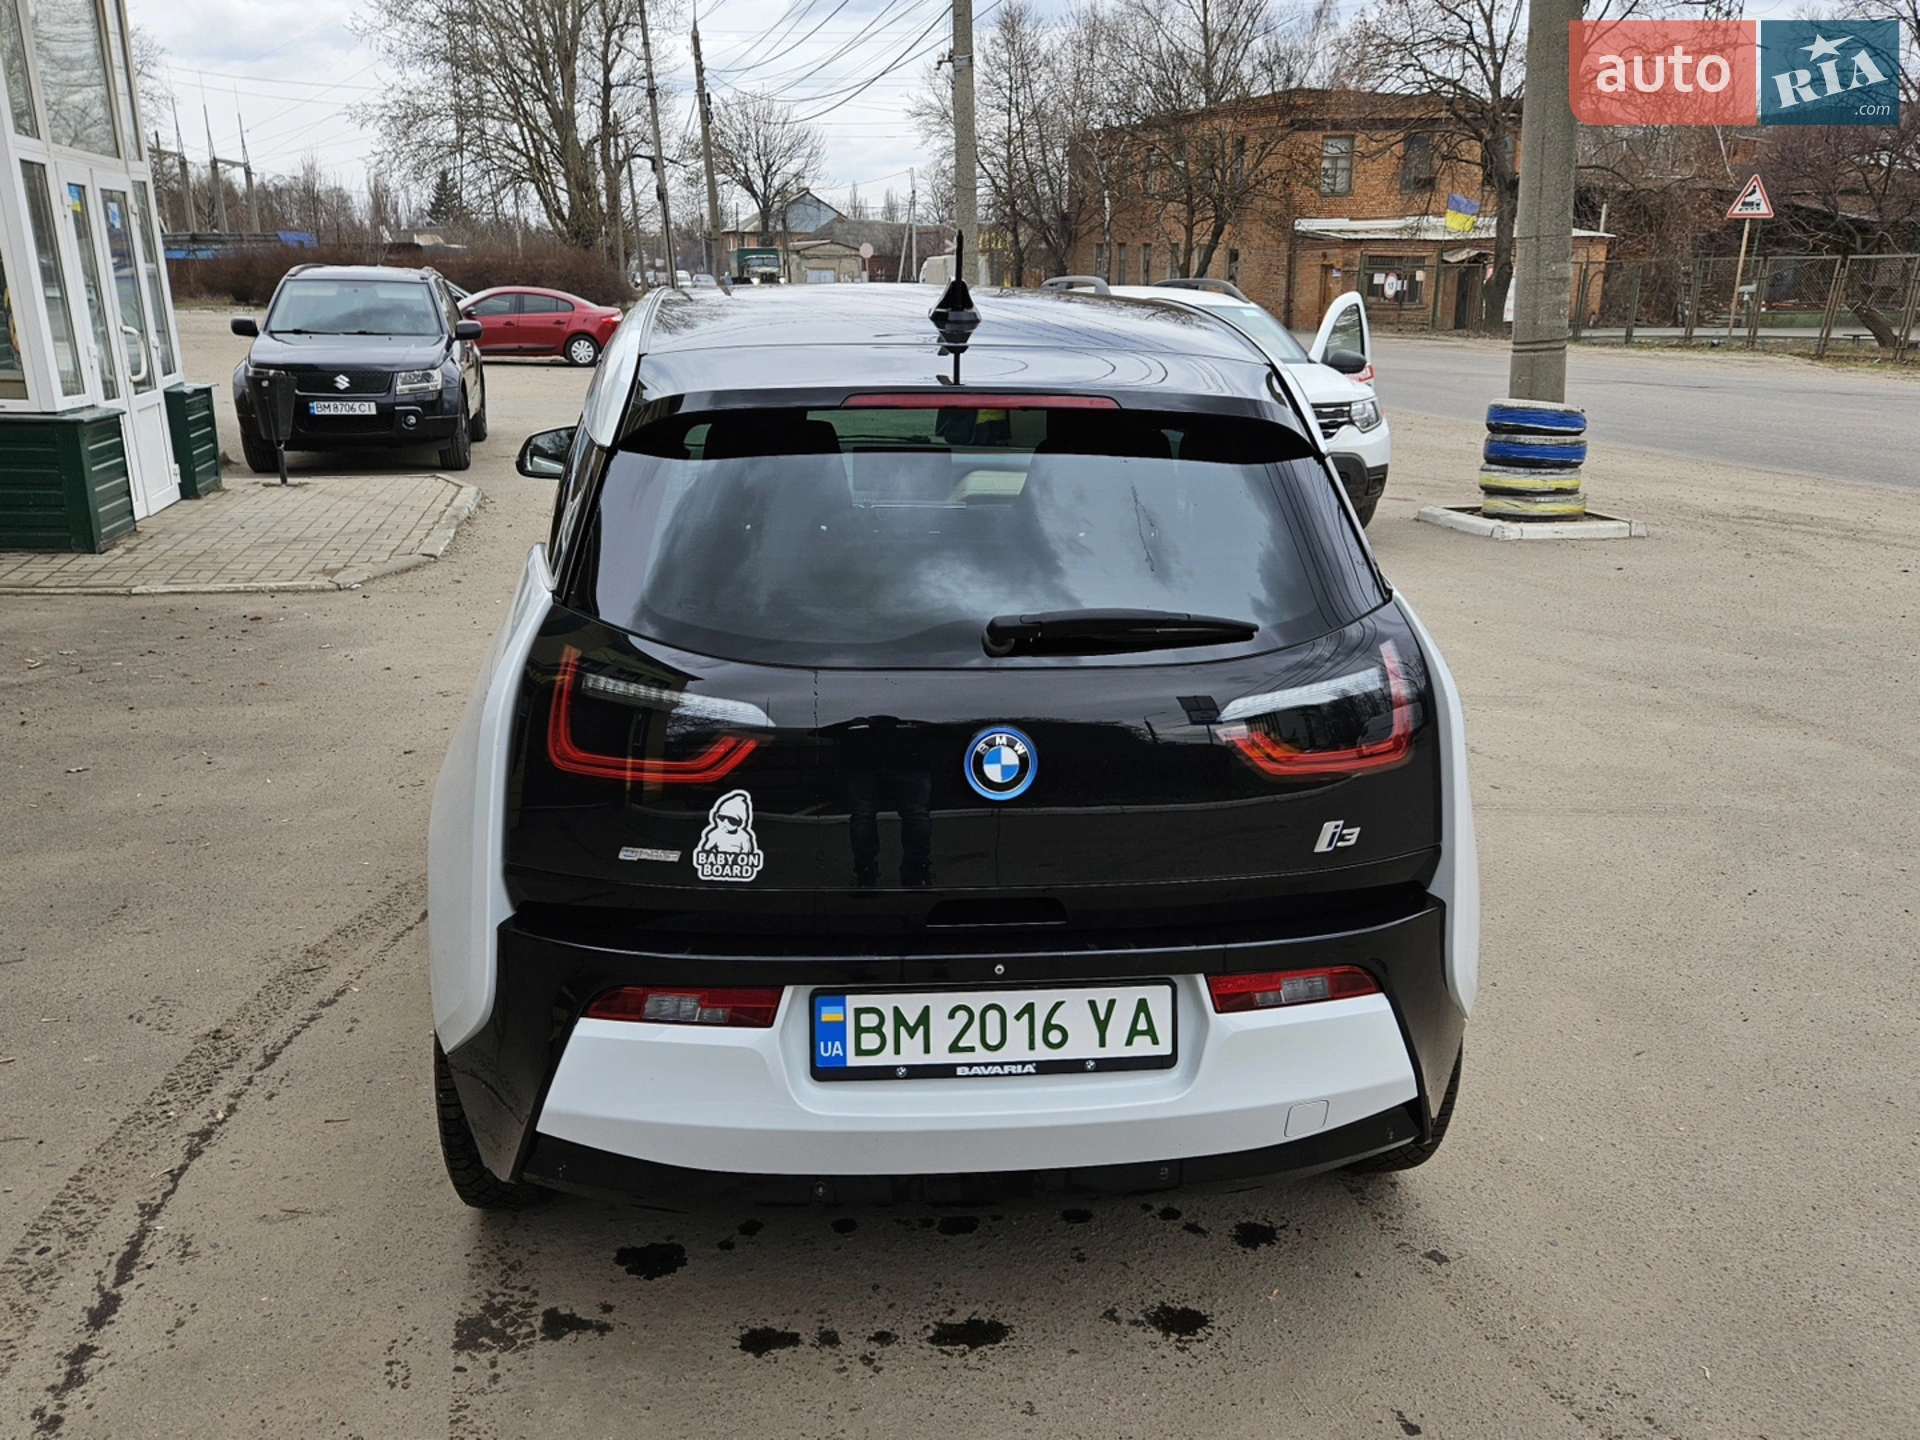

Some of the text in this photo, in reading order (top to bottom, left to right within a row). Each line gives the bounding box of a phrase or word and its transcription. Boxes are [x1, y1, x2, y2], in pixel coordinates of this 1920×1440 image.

[316, 403, 331, 413] BM
[333, 403, 357, 413] 8706
[976, 736, 1026, 755] BMW
[1313, 820, 1361, 853] i3
[698, 853, 759, 866] BABY ON
[703, 865, 752, 877] BOARD
[853, 997, 1160, 1057] BM 2016 YA
[820, 1041, 843, 1057] UA
